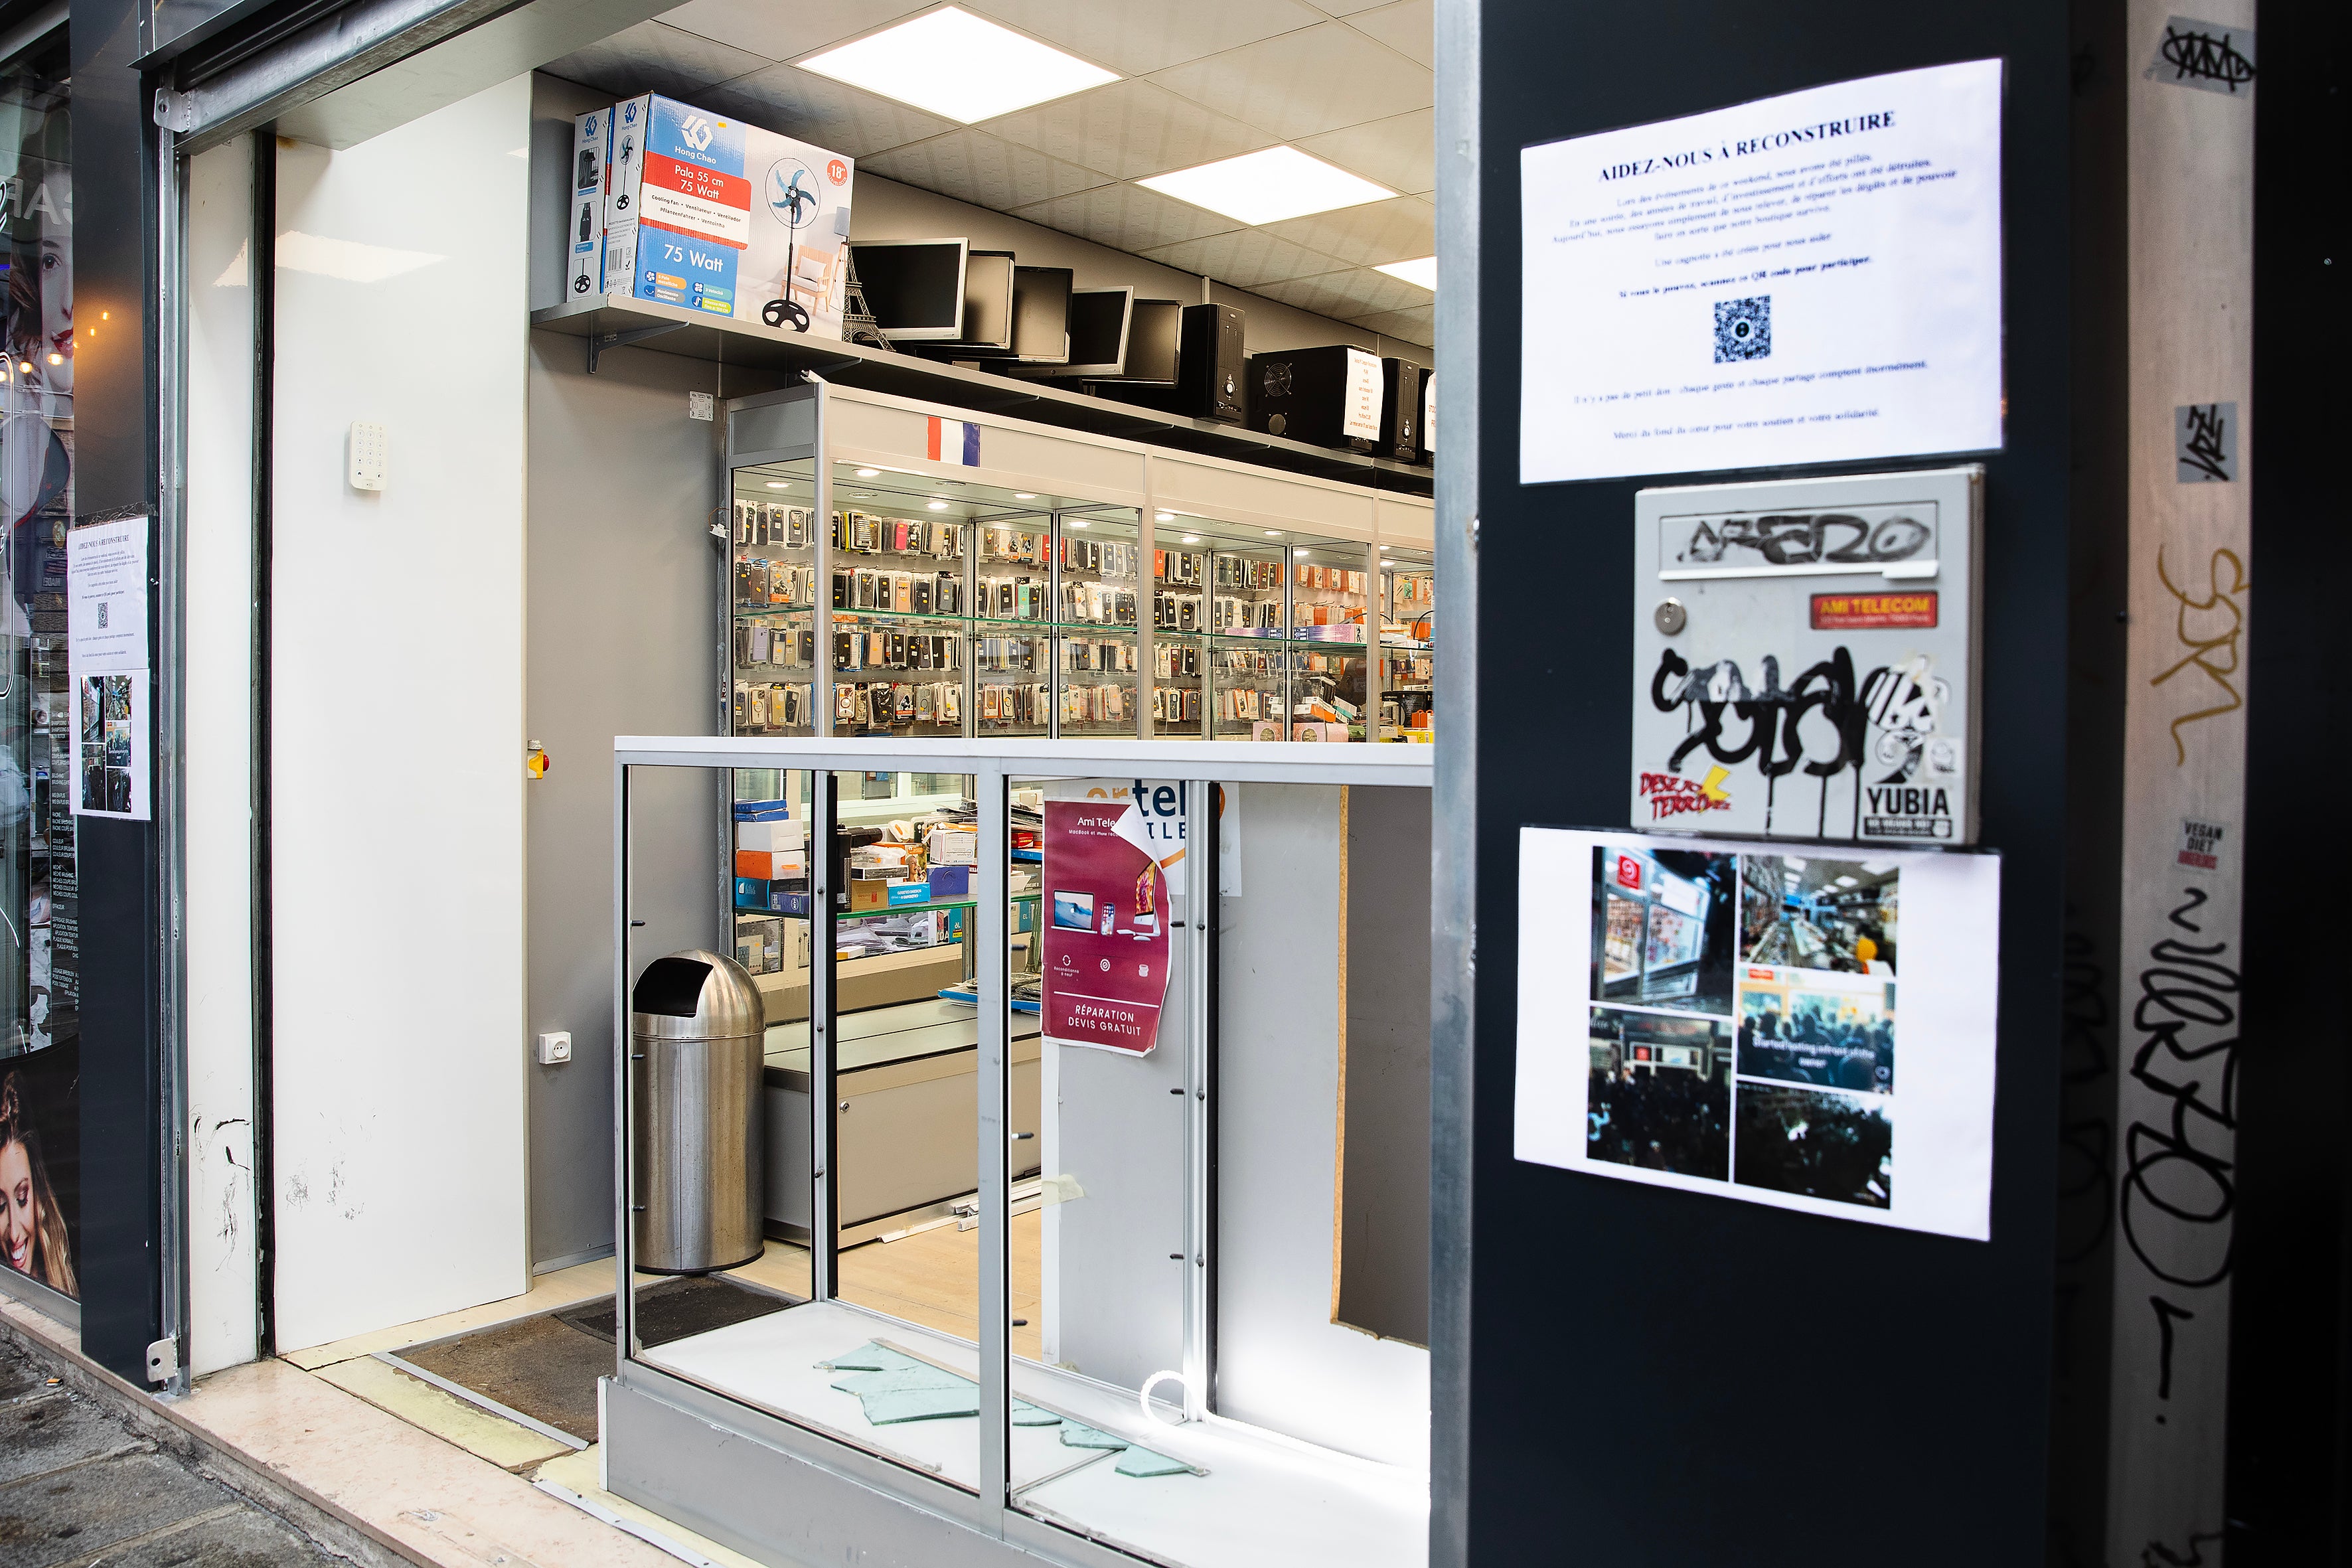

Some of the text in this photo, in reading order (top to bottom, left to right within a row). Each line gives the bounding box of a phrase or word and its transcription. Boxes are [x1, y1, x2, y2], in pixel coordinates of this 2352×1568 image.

[674, 145, 717, 164] Hong Chao
[1599, 111, 1896, 183] AIDEZ-NOUS À RECONSTRUIRE
[675, 165, 724, 187] Pala 55 cm
[680, 179, 720, 199] 75 Watt
[652, 195, 670, 204] Cooling
[685, 204, 712, 214] Ventilateur
[718, 212, 741, 222] Ventilador
[701, 218, 726, 228] Ventoinha
[664, 244, 724, 272] 75 Watt
[1821, 597, 1930, 614] AMI TELECOM
[1867, 787, 1950, 815] YUBIA
[1077, 817, 1094, 826] Ami
[2184, 822, 2223, 841] VEGAN
[2187, 836, 2215, 853] DIET
[1075, 1004, 1134, 1023] RÉPARATION
[1068, 1016, 1141, 1036] DEVIS GRATUIT
